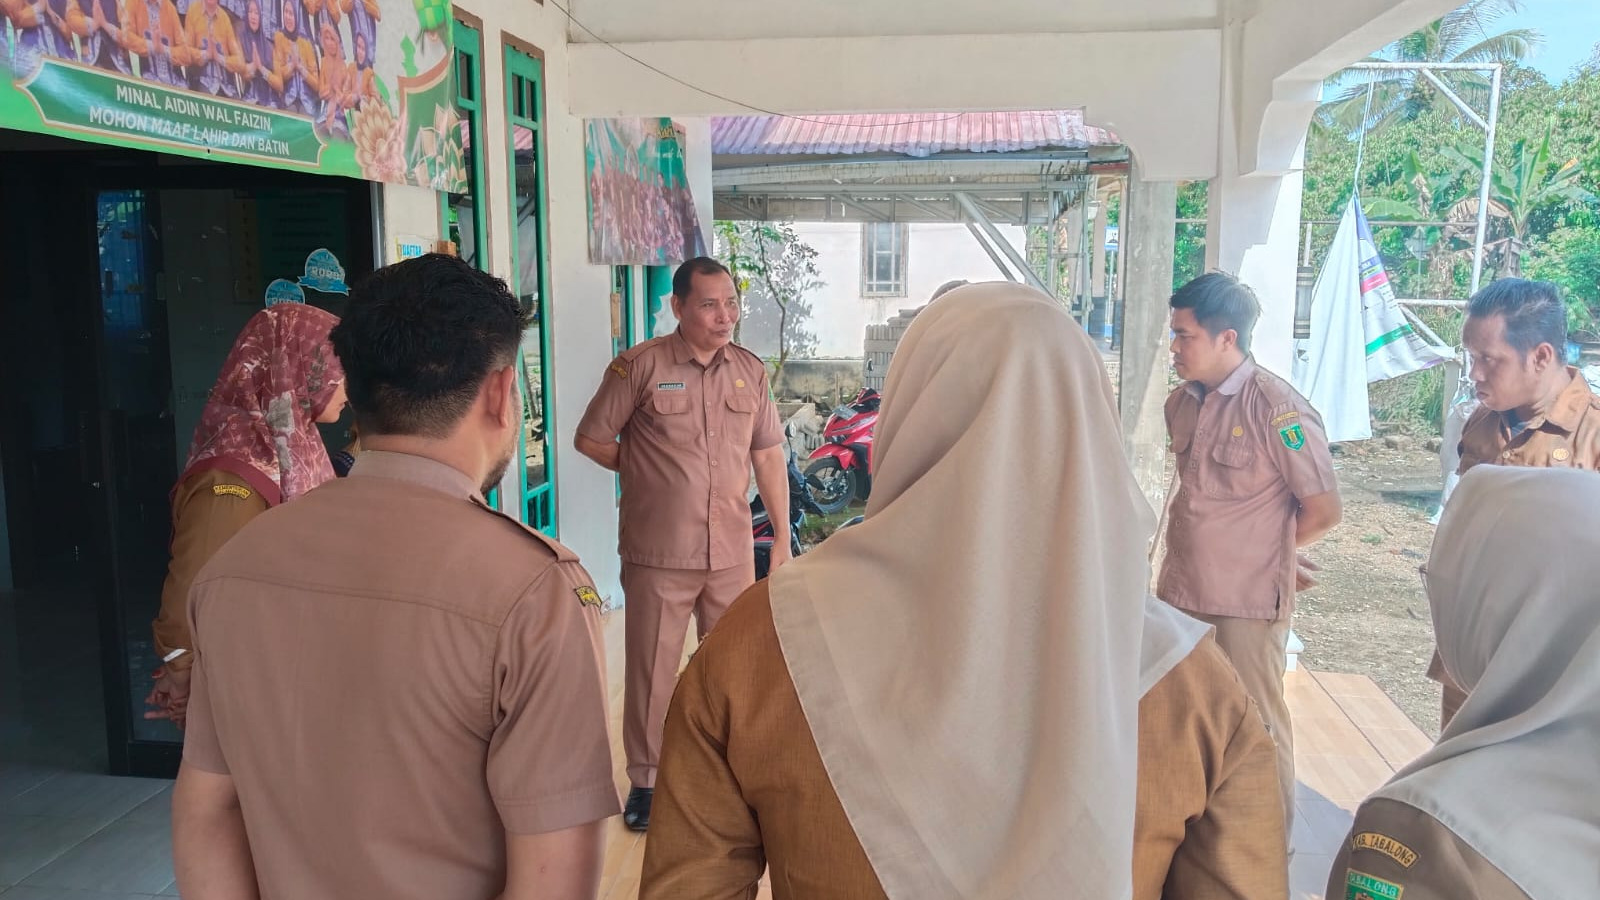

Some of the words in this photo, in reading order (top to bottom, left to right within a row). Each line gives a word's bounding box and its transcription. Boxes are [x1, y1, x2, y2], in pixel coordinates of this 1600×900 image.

[89, 105, 147, 131] MOHON
[151, 118, 191, 138] MAAF
[193, 125, 229, 146] LAHIR
[231, 132, 256, 151] DAN
[258, 137, 290, 156] BATIN
[116, 84, 161, 109] MINAL
[165, 96, 200, 117] AIDIN
[202, 103, 232, 124] WAL
[234, 110, 273, 134] FAIZIN,
[1370, 835, 1414, 864] TABALONG
